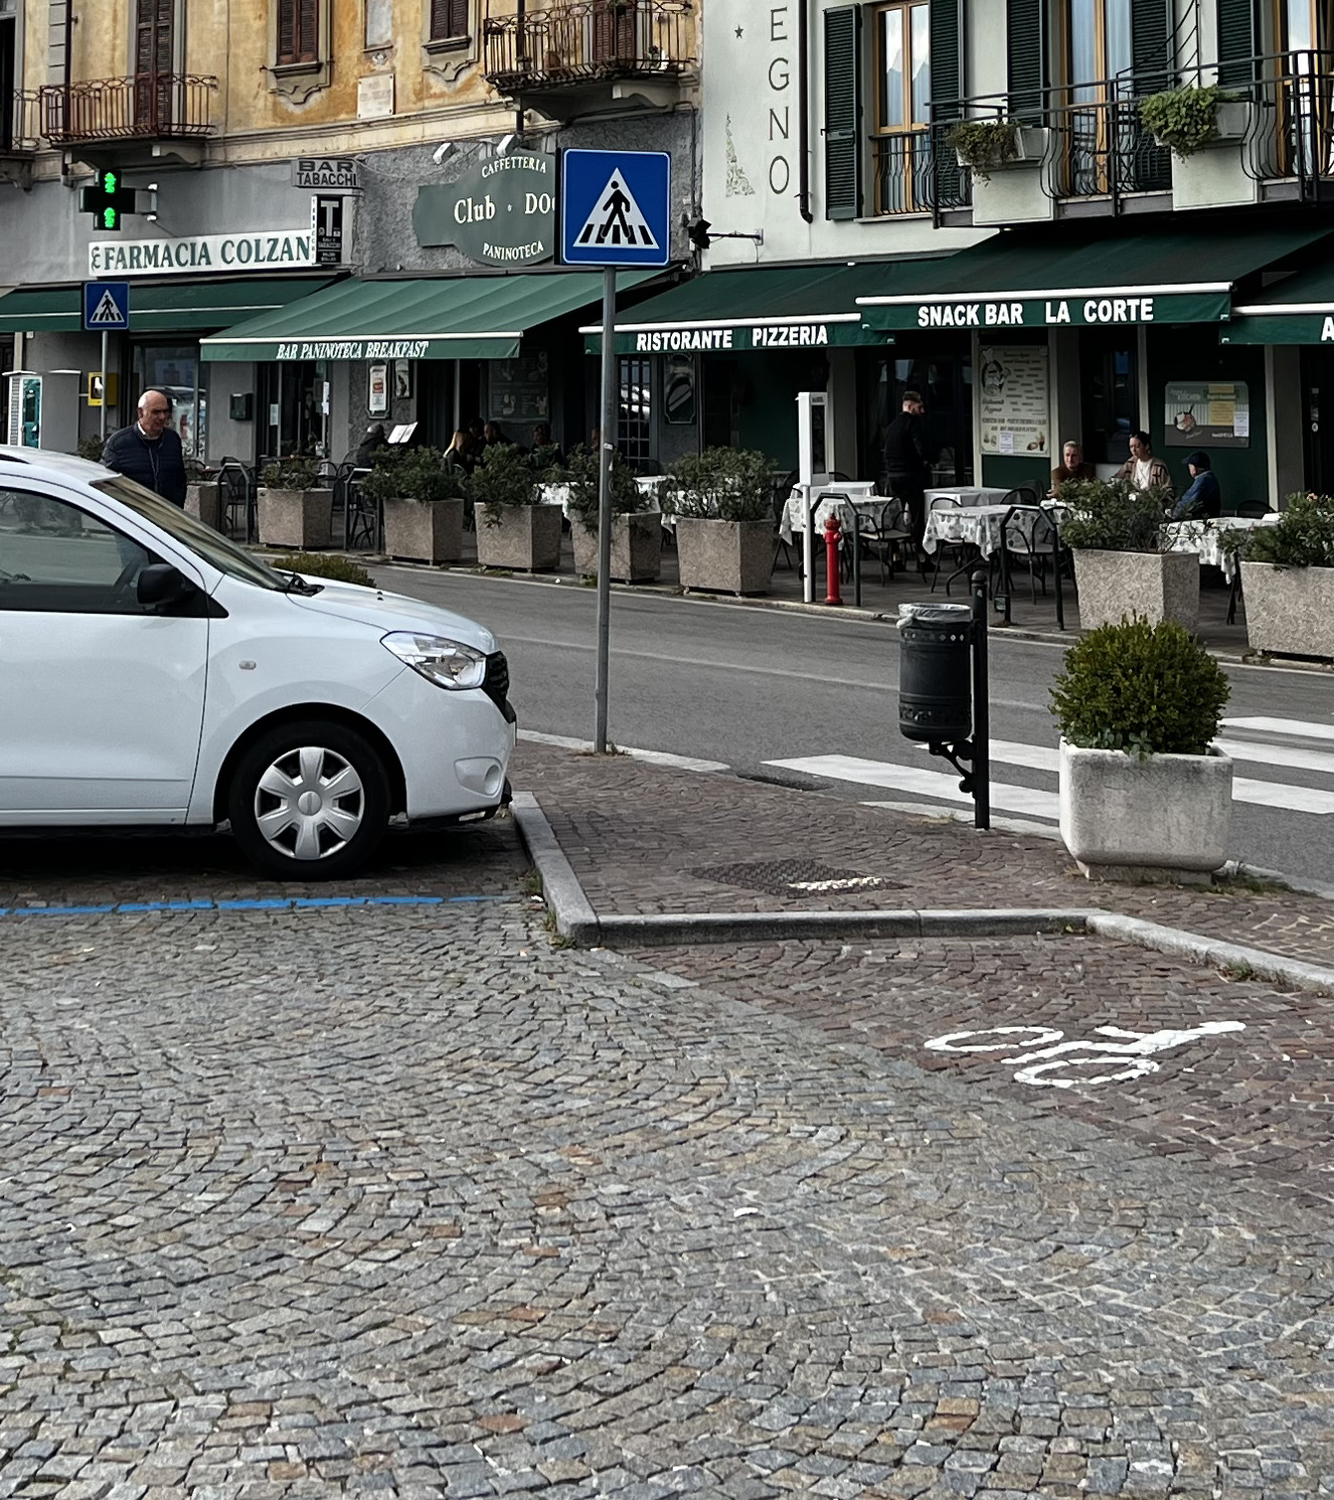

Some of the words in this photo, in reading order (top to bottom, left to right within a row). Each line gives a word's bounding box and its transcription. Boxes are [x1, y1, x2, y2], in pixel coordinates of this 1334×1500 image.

[299, 161, 353, 172] BAR
[481, 156, 547, 178] CAFFETTERIA
[297, 172, 357, 186] TABACCHI
[454, 194, 496, 224] Club
[525, 193, 555, 214] DO
[104, 242, 212, 270] FARMACIA
[482, 240, 544, 261] PANINOTECA
[918, 304, 980, 327] SNACK
[985, 303, 1024, 325] BAR
[1045, 301, 1071, 323] LA
[1084, 298, 1154, 323] CORTE
[636, 329, 733, 351] RISTORANTE
[752, 325, 828, 347] PIZZERIA
[276, 344, 298, 359] BAR
[300, 342, 362, 359] PANINOTECA
[365, 341, 429, 358] BREAKFAST
